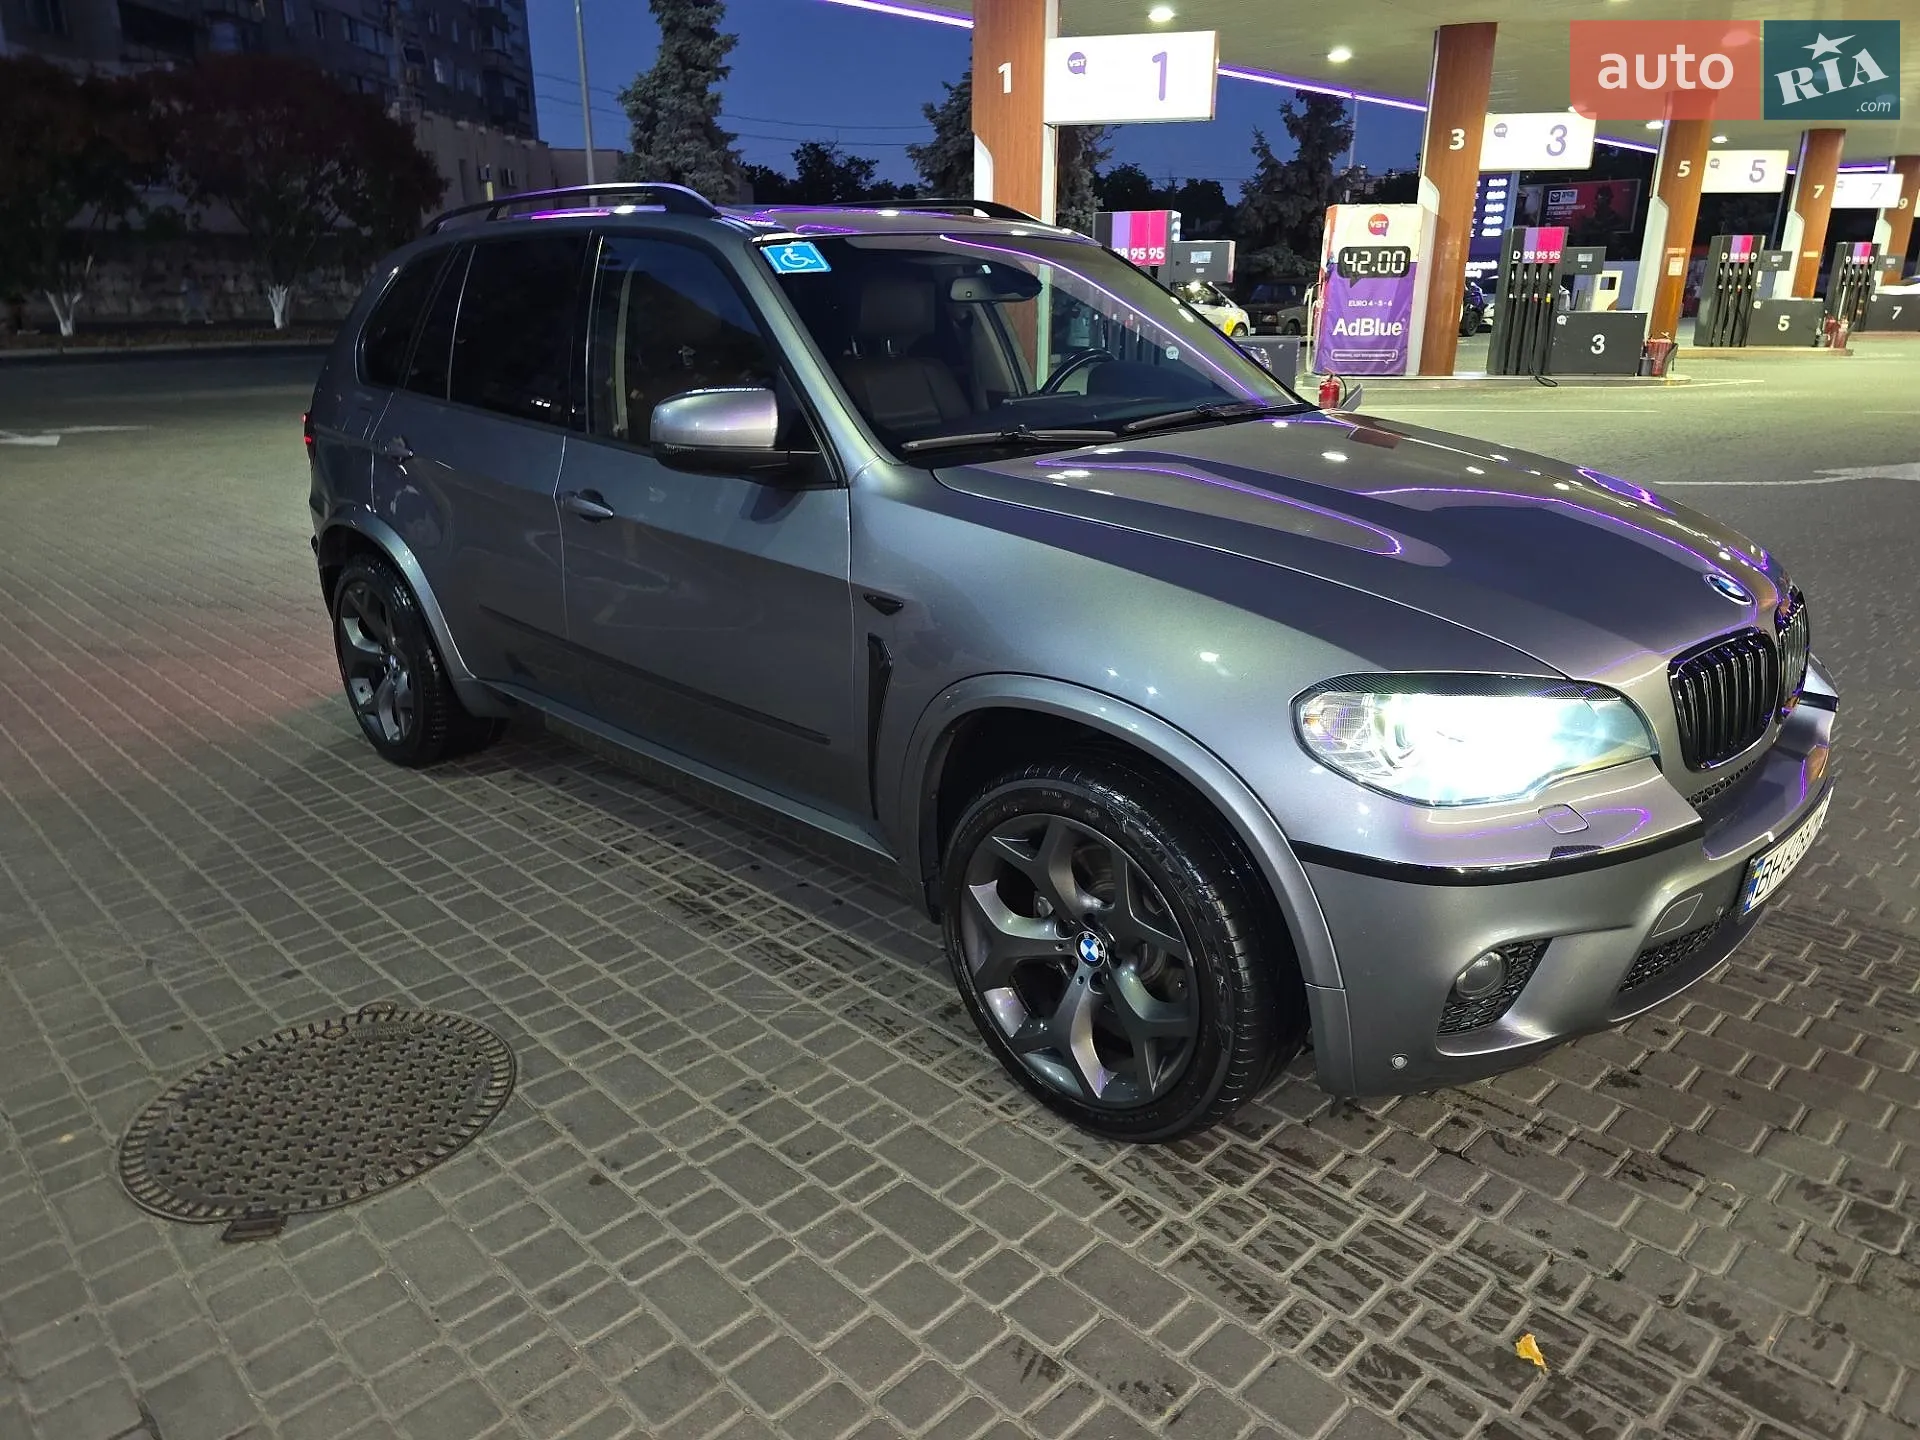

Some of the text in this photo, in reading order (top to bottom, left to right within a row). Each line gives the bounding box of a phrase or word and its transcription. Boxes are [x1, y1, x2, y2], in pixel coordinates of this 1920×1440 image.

[997, 61, 1012, 94] 1
[1152, 51, 1168, 101] 1
[1449, 128, 1465, 151] 3
[1546, 124, 1568, 157] 3
[1677, 160, 1691, 178] 5
[1749, 159, 1767, 183] 5
[1813, 184, 1825, 199] 7
[1870, 182, 1883, 200] 7
[1898, 198, 1908, 210] 9
[1370, 220, 1388, 229] VST
[1130, 247, 1147, 261] 95
[1148, 247, 1166, 261] 95
[1343, 250, 1406, 274] 42.00
[1512, 250, 1521, 260] D
[1536, 250, 1549, 260] 95
[1549, 250, 1562, 260] 95
[1892, 306, 1903, 320] 7
[1332, 317, 1403, 337] AdBlue
[1777, 315, 1790, 332] 5
[1590, 333, 1605, 355] 3
